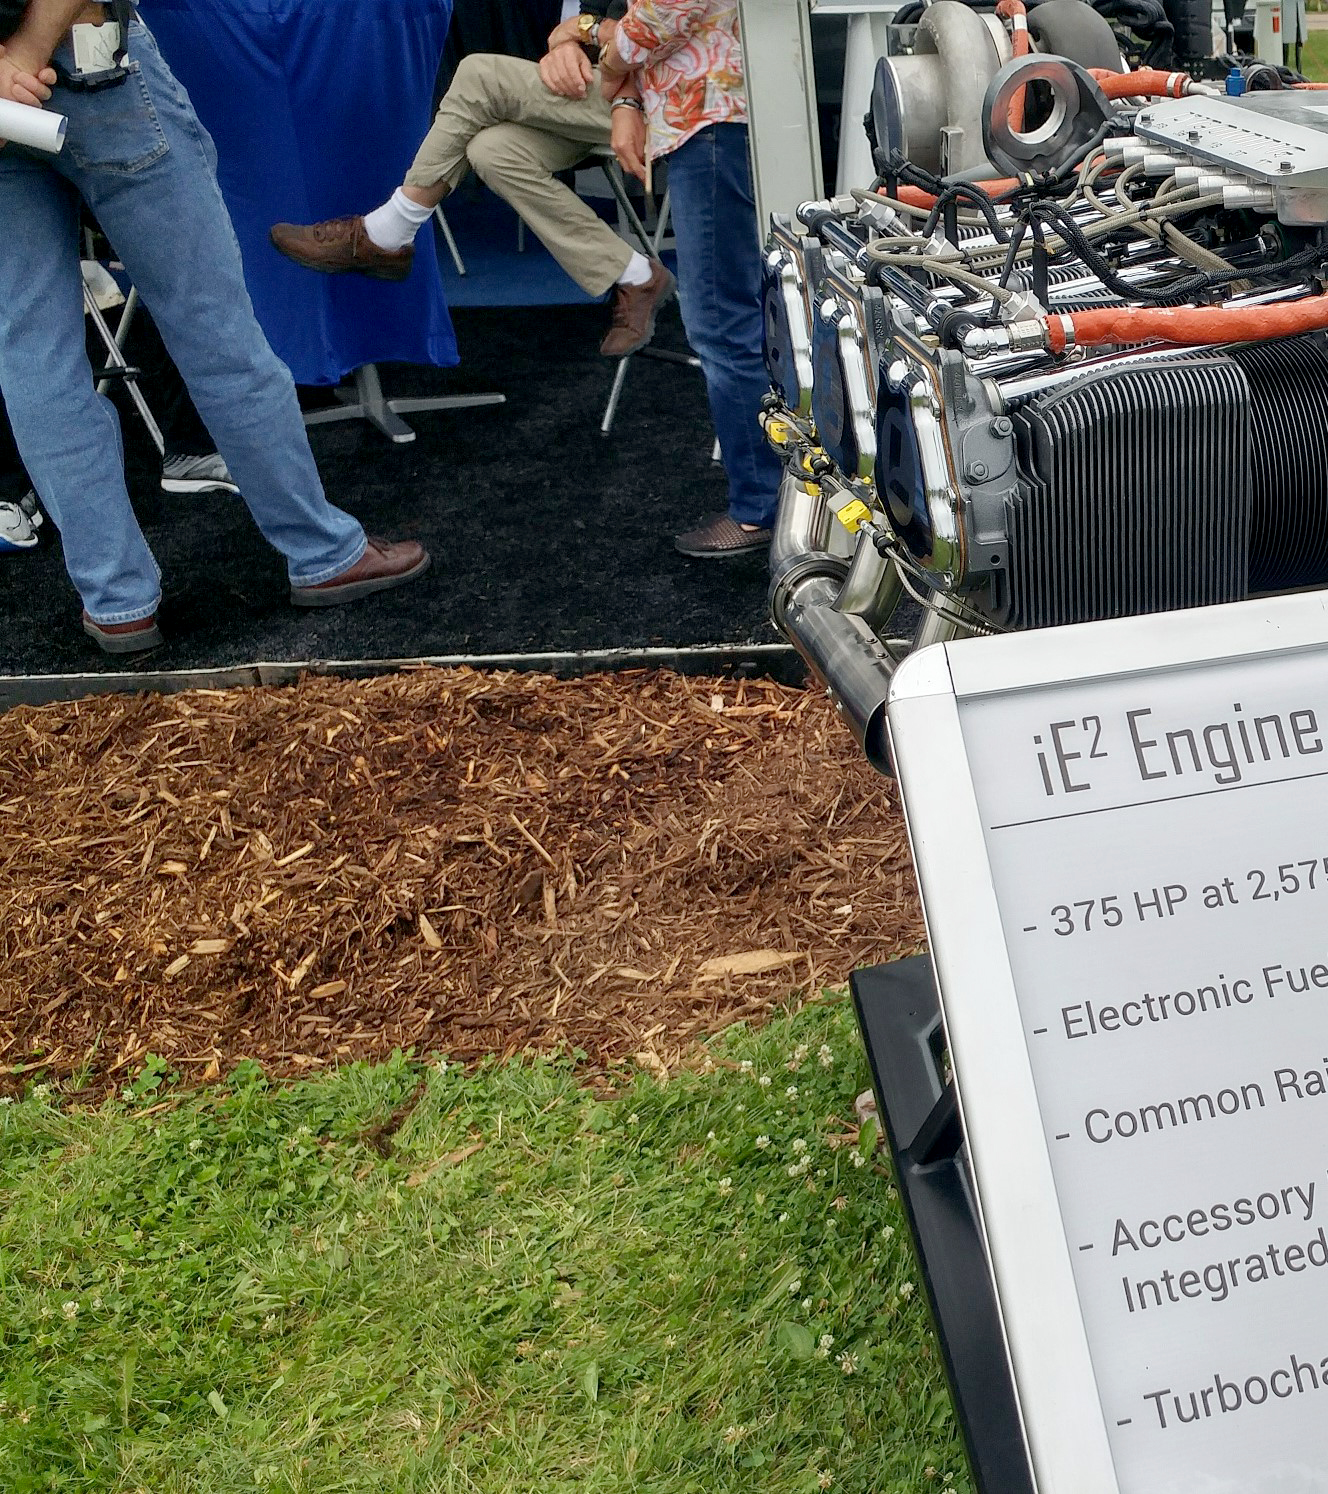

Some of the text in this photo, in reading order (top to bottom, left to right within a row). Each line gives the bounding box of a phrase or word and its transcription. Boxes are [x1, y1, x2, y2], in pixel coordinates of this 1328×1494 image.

[1125, 702, 1324, 786] Engine
[1050, 899, 1124, 937] 375
[1133, 884, 1189, 922] HP
[1201, 876, 1240, 909] at
[1061, 974, 1254, 1040] Electronic
[1084, 1080, 1266, 1144] Common
[1111, 1181, 1315, 1257] Accessory
